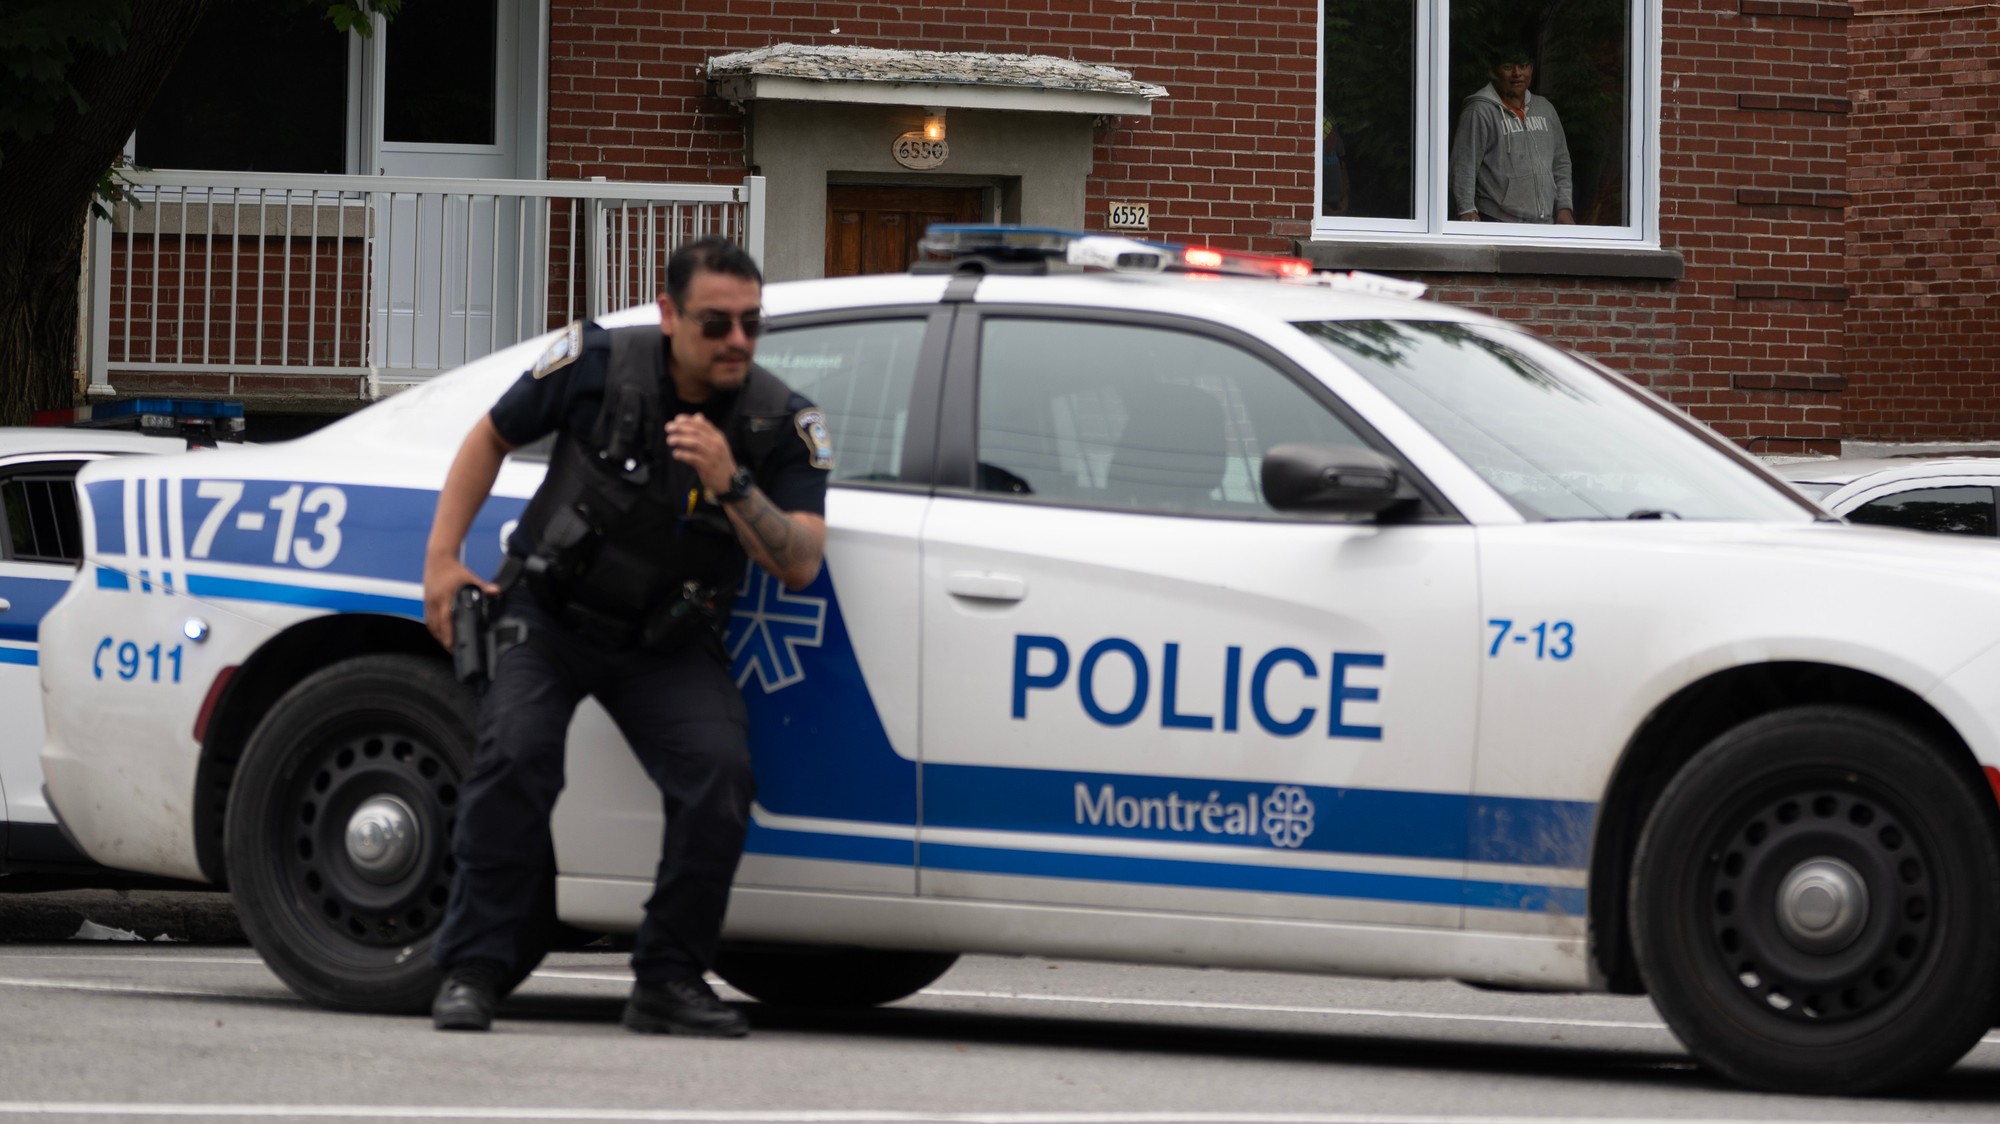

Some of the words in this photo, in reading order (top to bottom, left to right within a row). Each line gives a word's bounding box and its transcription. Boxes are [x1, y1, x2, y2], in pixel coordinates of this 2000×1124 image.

[1526, 116, 1549, 132] NAVY
[899, 141, 944, 160] 6550
[1112, 205, 1146, 226] 6552
[190, 481, 348, 569] 7-13
[1486, 619, 1576, 661] 7-13
[117, 641, 183, 683] 911
[1010, 633, 1386, 741] POLICE
[1074, 782, 1259, 836] Montréal
